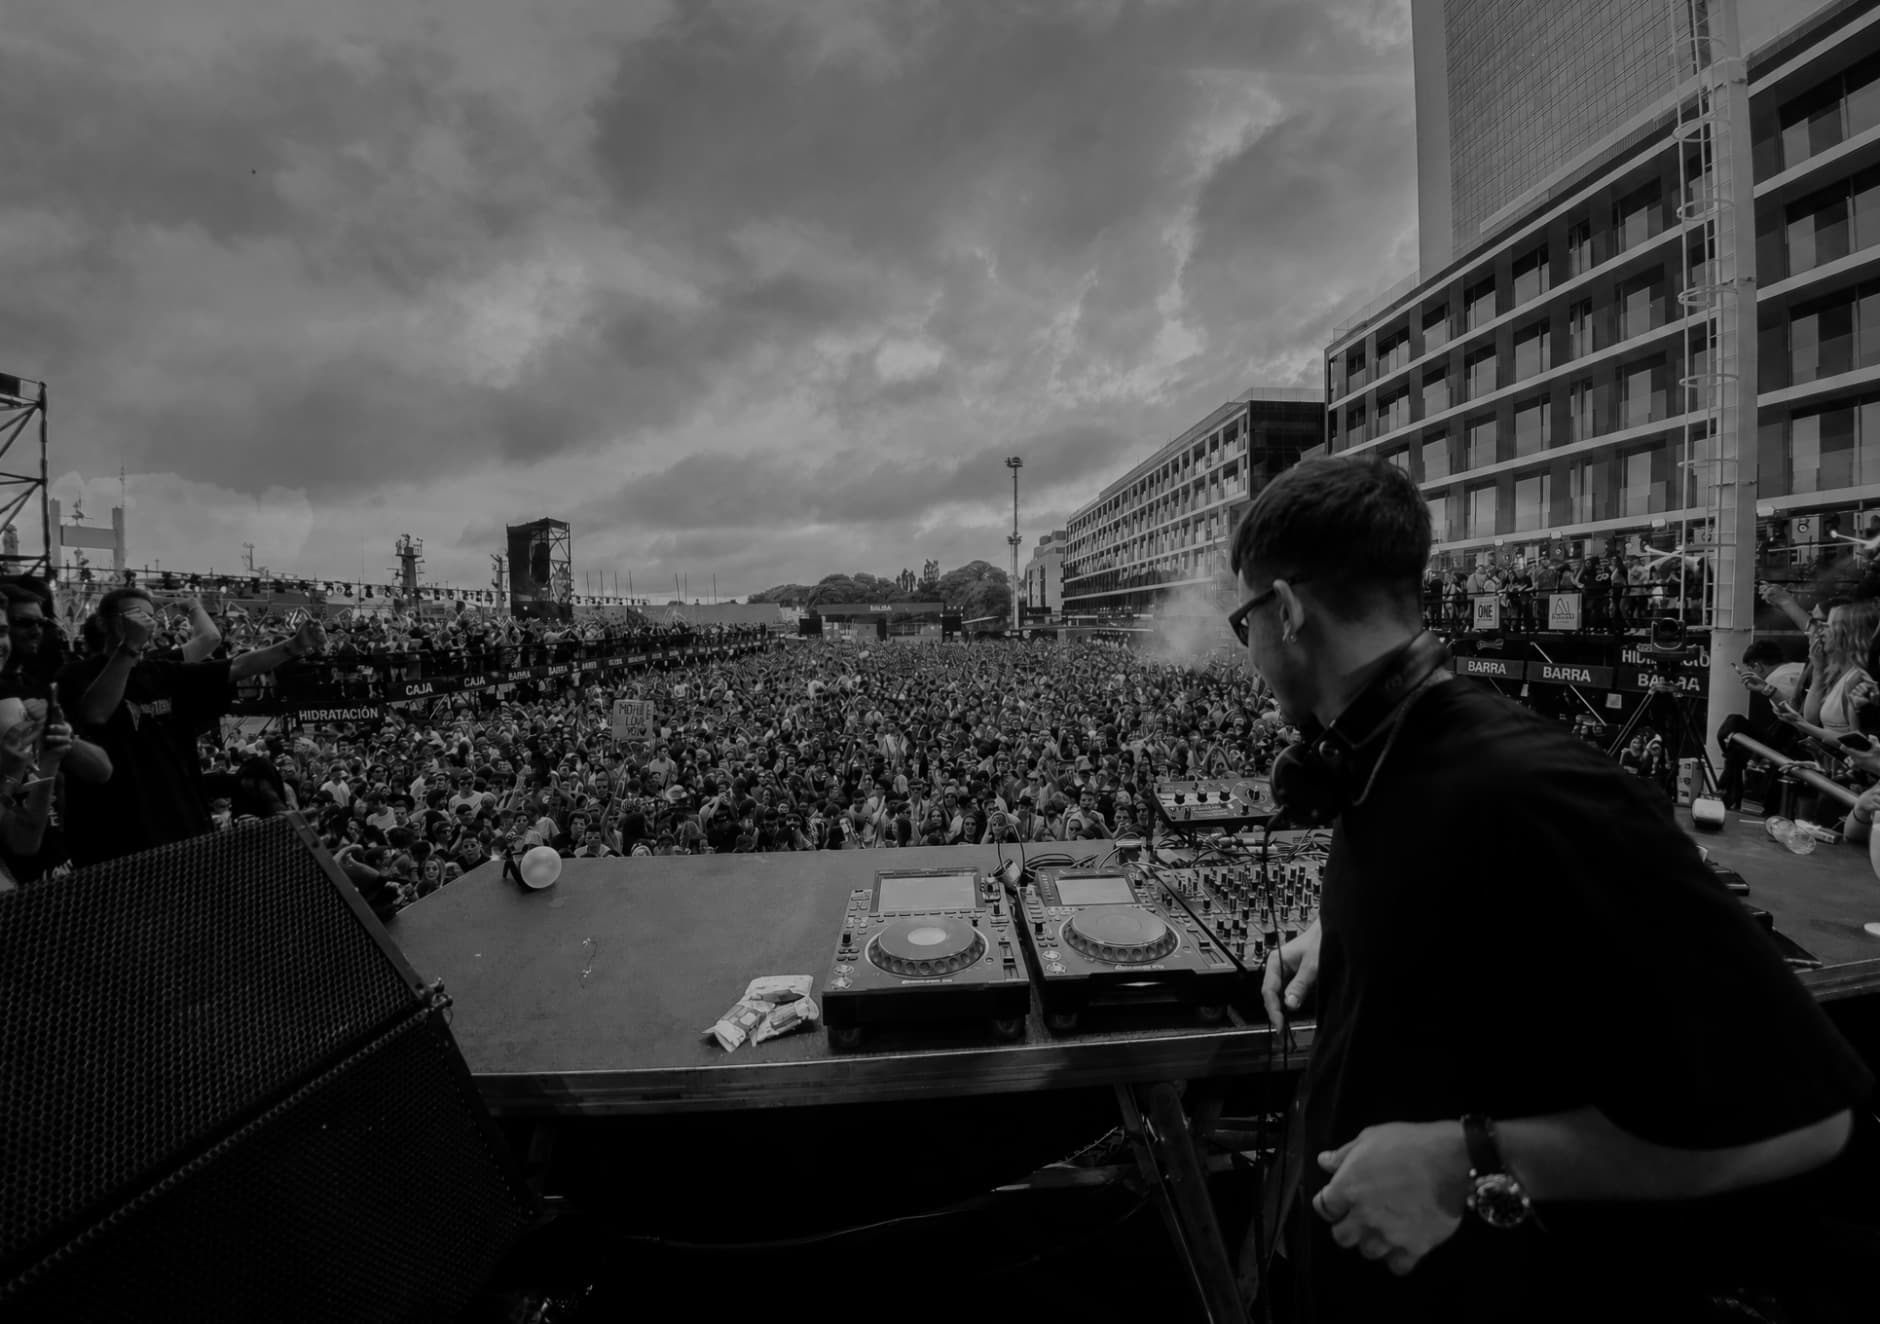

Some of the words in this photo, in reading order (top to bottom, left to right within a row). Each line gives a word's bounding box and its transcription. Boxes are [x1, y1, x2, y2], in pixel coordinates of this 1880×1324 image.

[1478, 604, 1493, 618] ONE
[1467, 661, 1507, 675] BARRA
[1543, 666, 1591, 684] BARRA
[463, 676, 486, 688] CAJA
[405, 683, 433, 696] CAJA
[298, 706, 379, 722] HIDRATACIÓN
